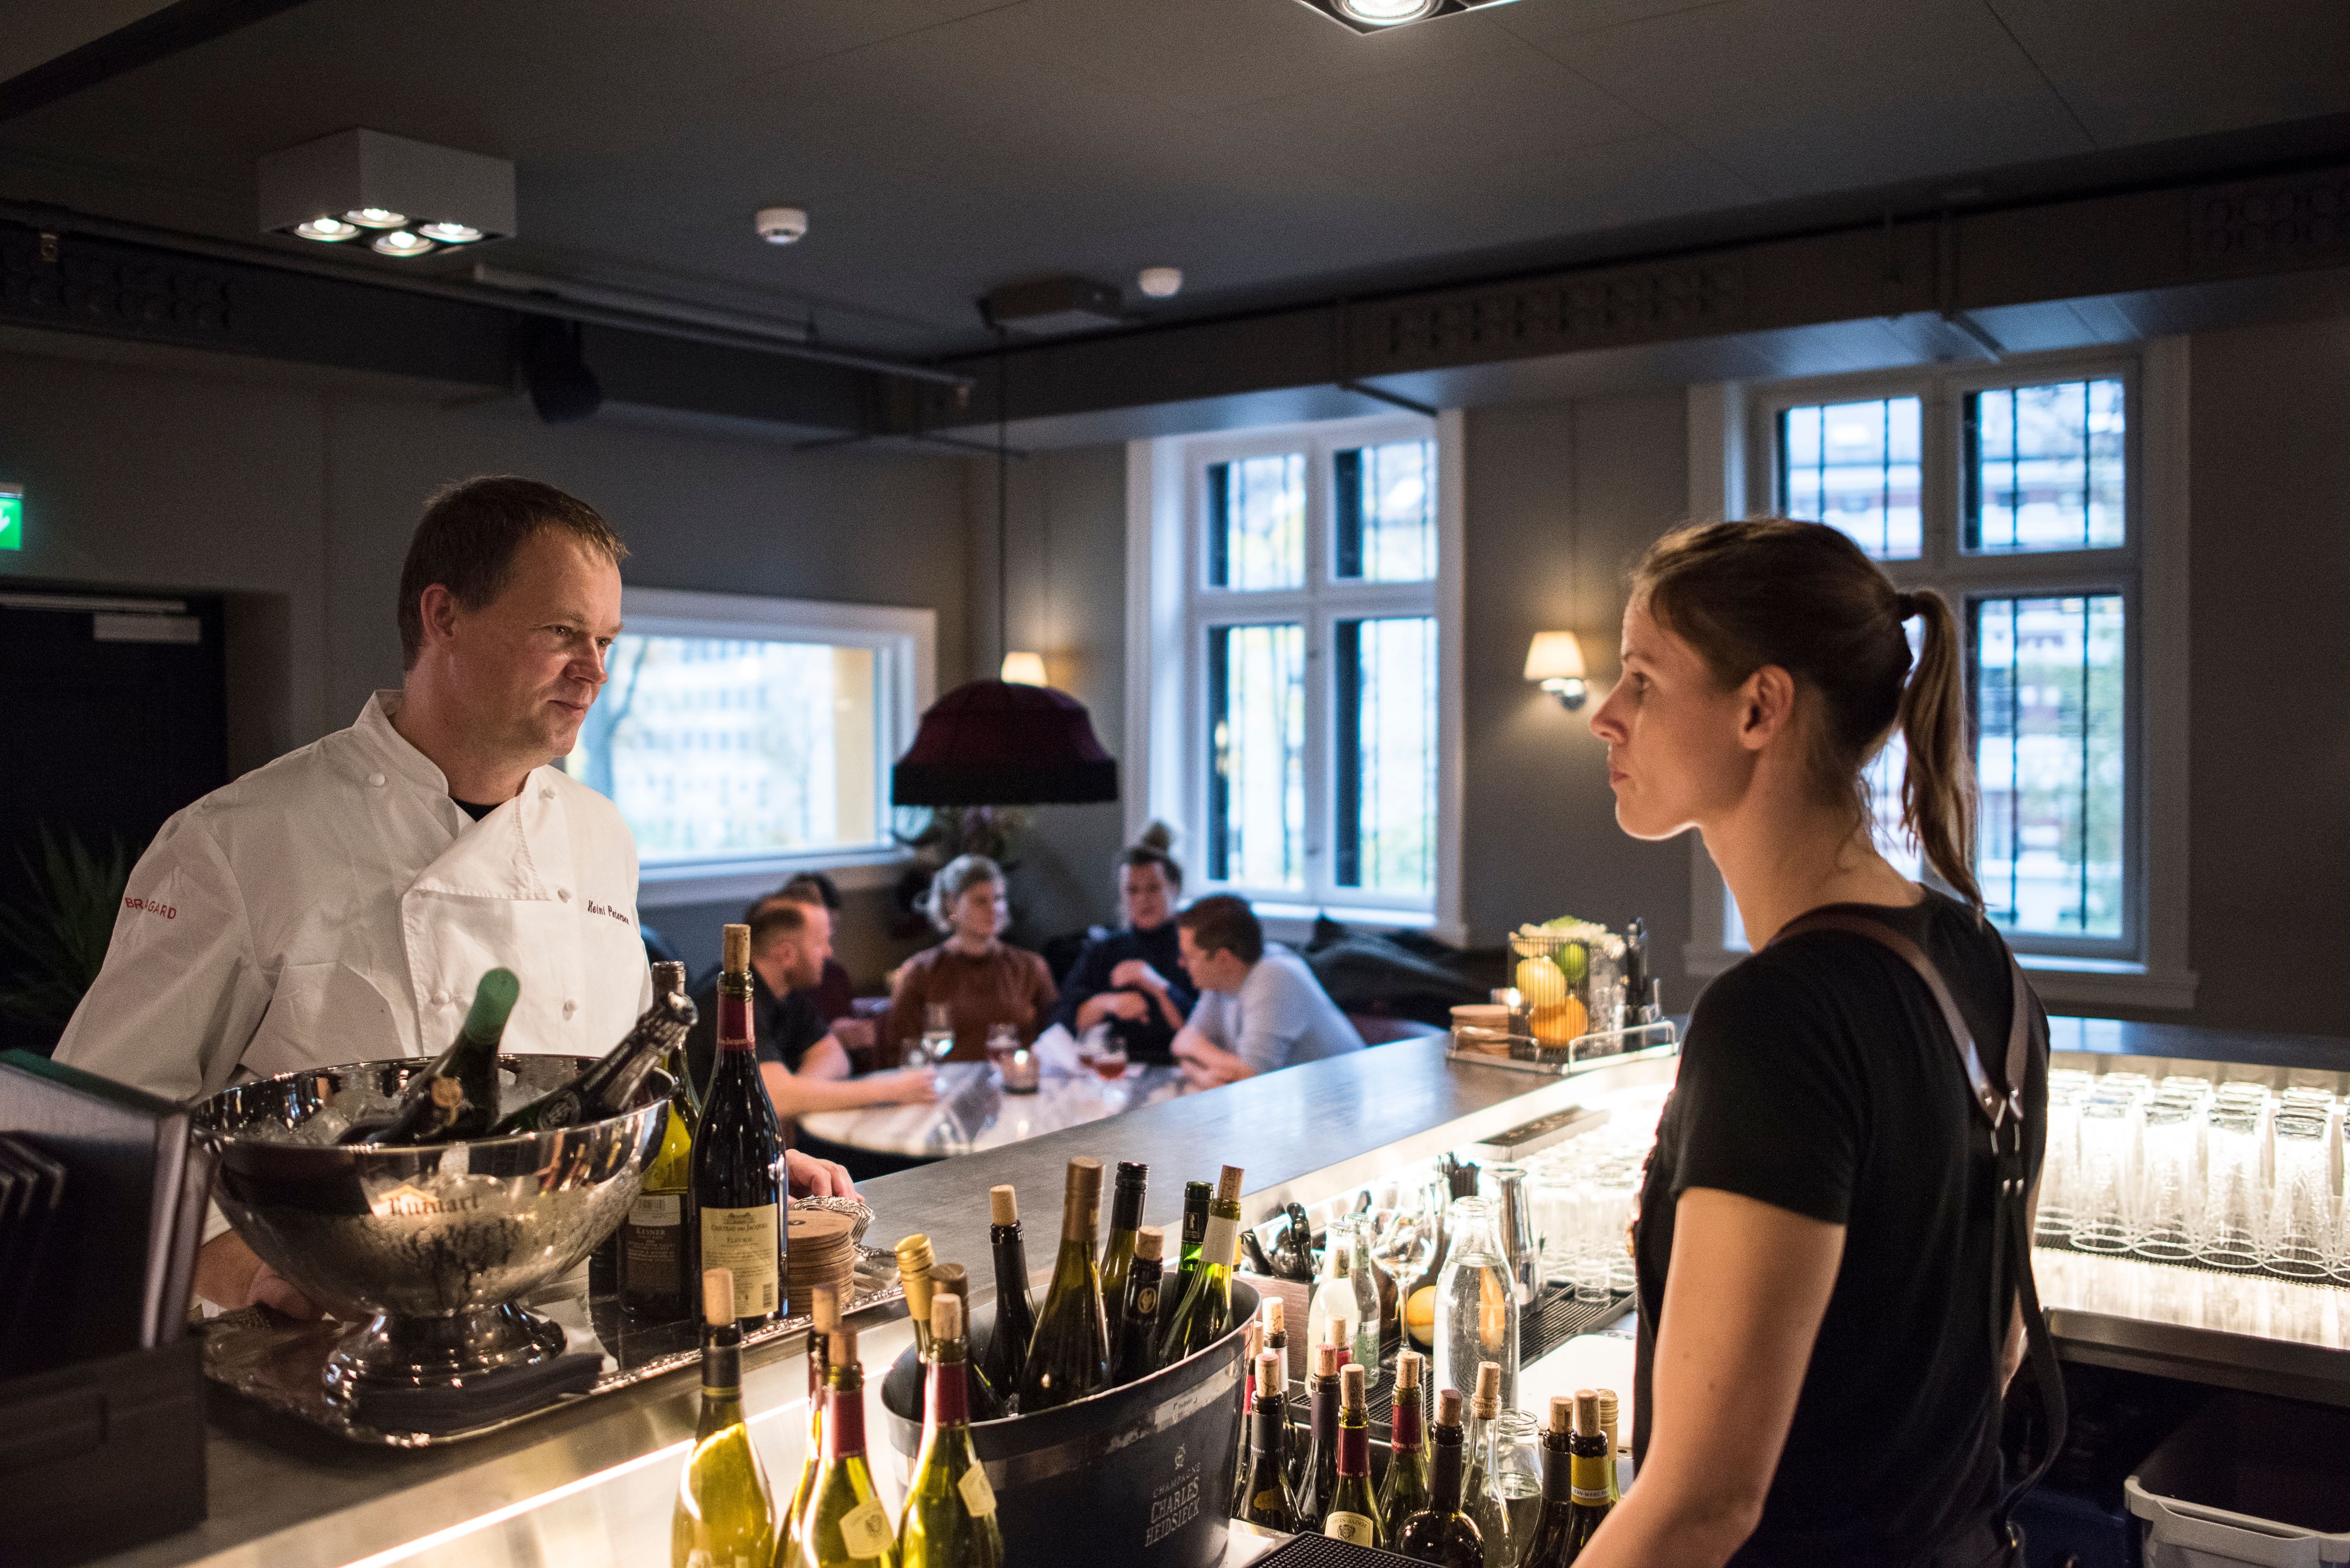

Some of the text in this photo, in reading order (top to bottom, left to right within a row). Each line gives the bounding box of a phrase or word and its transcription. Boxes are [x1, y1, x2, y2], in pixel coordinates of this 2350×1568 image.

[588, 900, 606, 915] Heini
[1150, 1477, 1200, 1524] CHARLES
[1145, 1497, 1200, 1547] HEIDSIECK
[1346, 1519, 1367, 1529] JADOT
